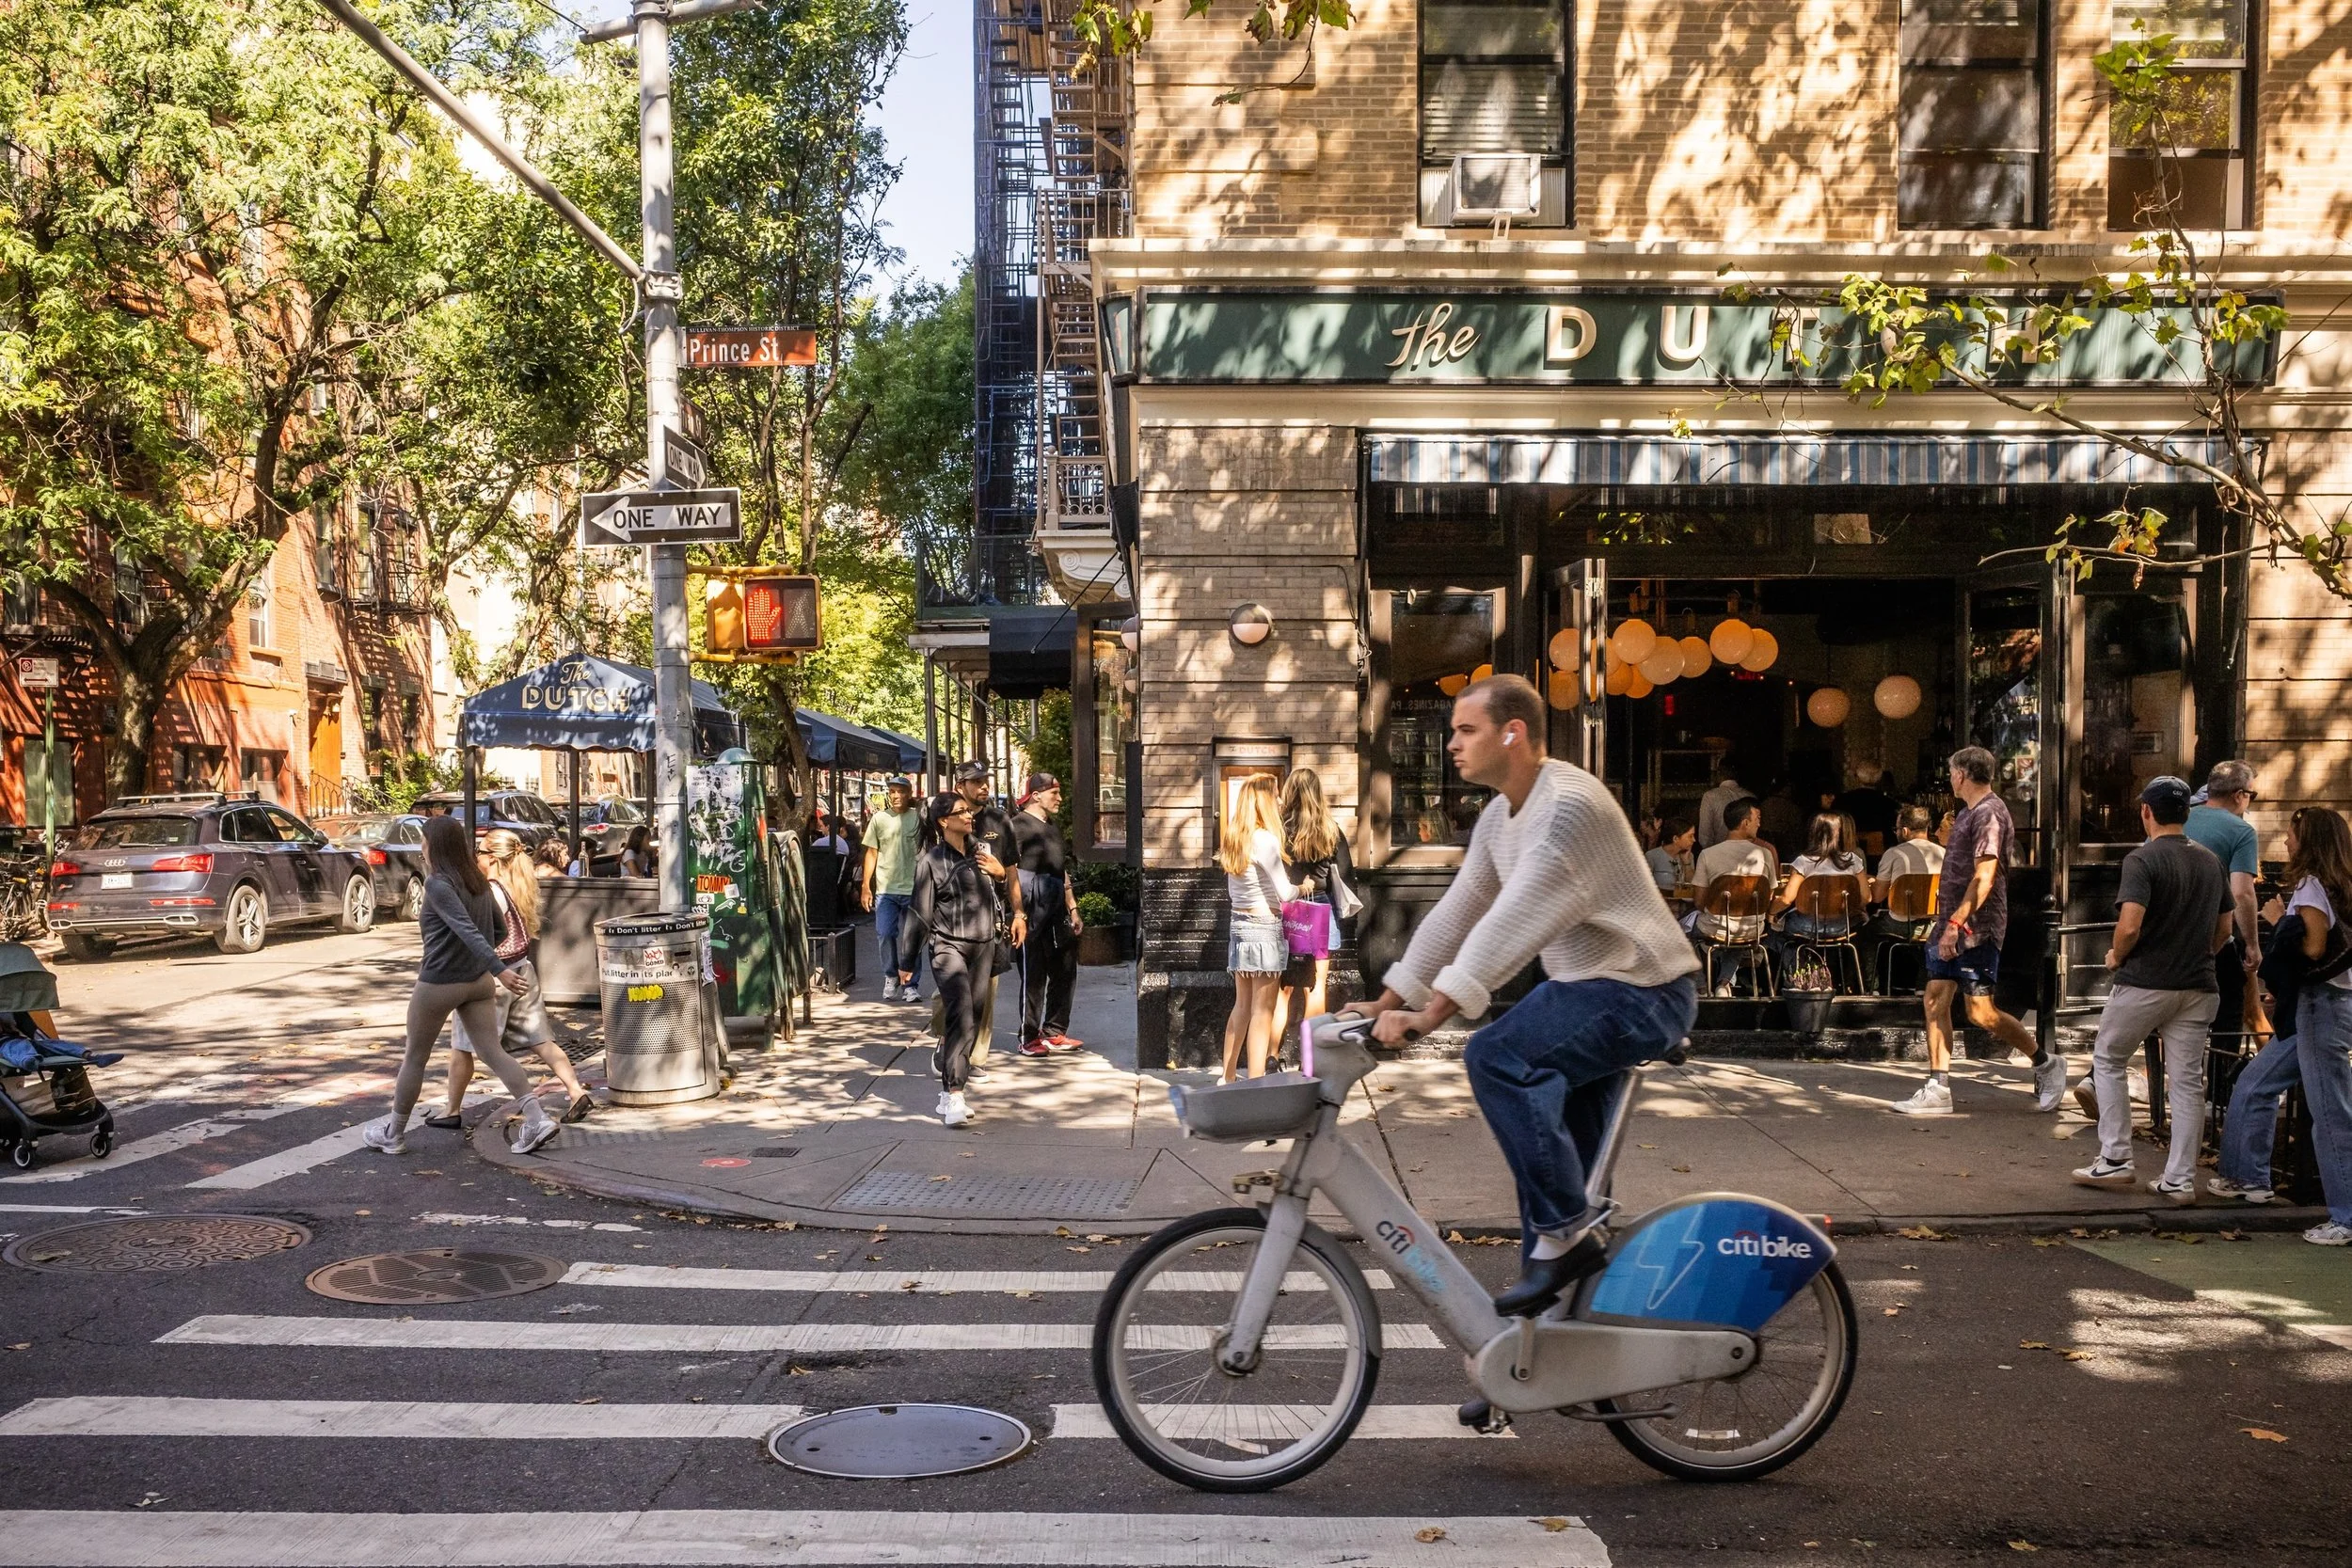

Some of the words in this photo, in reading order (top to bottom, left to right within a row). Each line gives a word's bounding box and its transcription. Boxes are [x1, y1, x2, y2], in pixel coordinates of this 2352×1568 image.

[690, 338, 750, 362] Prince
[759, 337, 779, 362] St
[669, 446, 683, 471] ONE
[687, 456, 701, 481] WAY
[613, 509, 656, 529] ONE
[676, 506, 722, 526] WAY
[560, 661, 592, 685] The
[521, 685, 631, 712] DUTCH
[699, 875, 729, 893] TOMMY
[675, 920, 695, 930] Don't
[611, 969, 628, 978] litter
[630, 970, 639, 978] in
